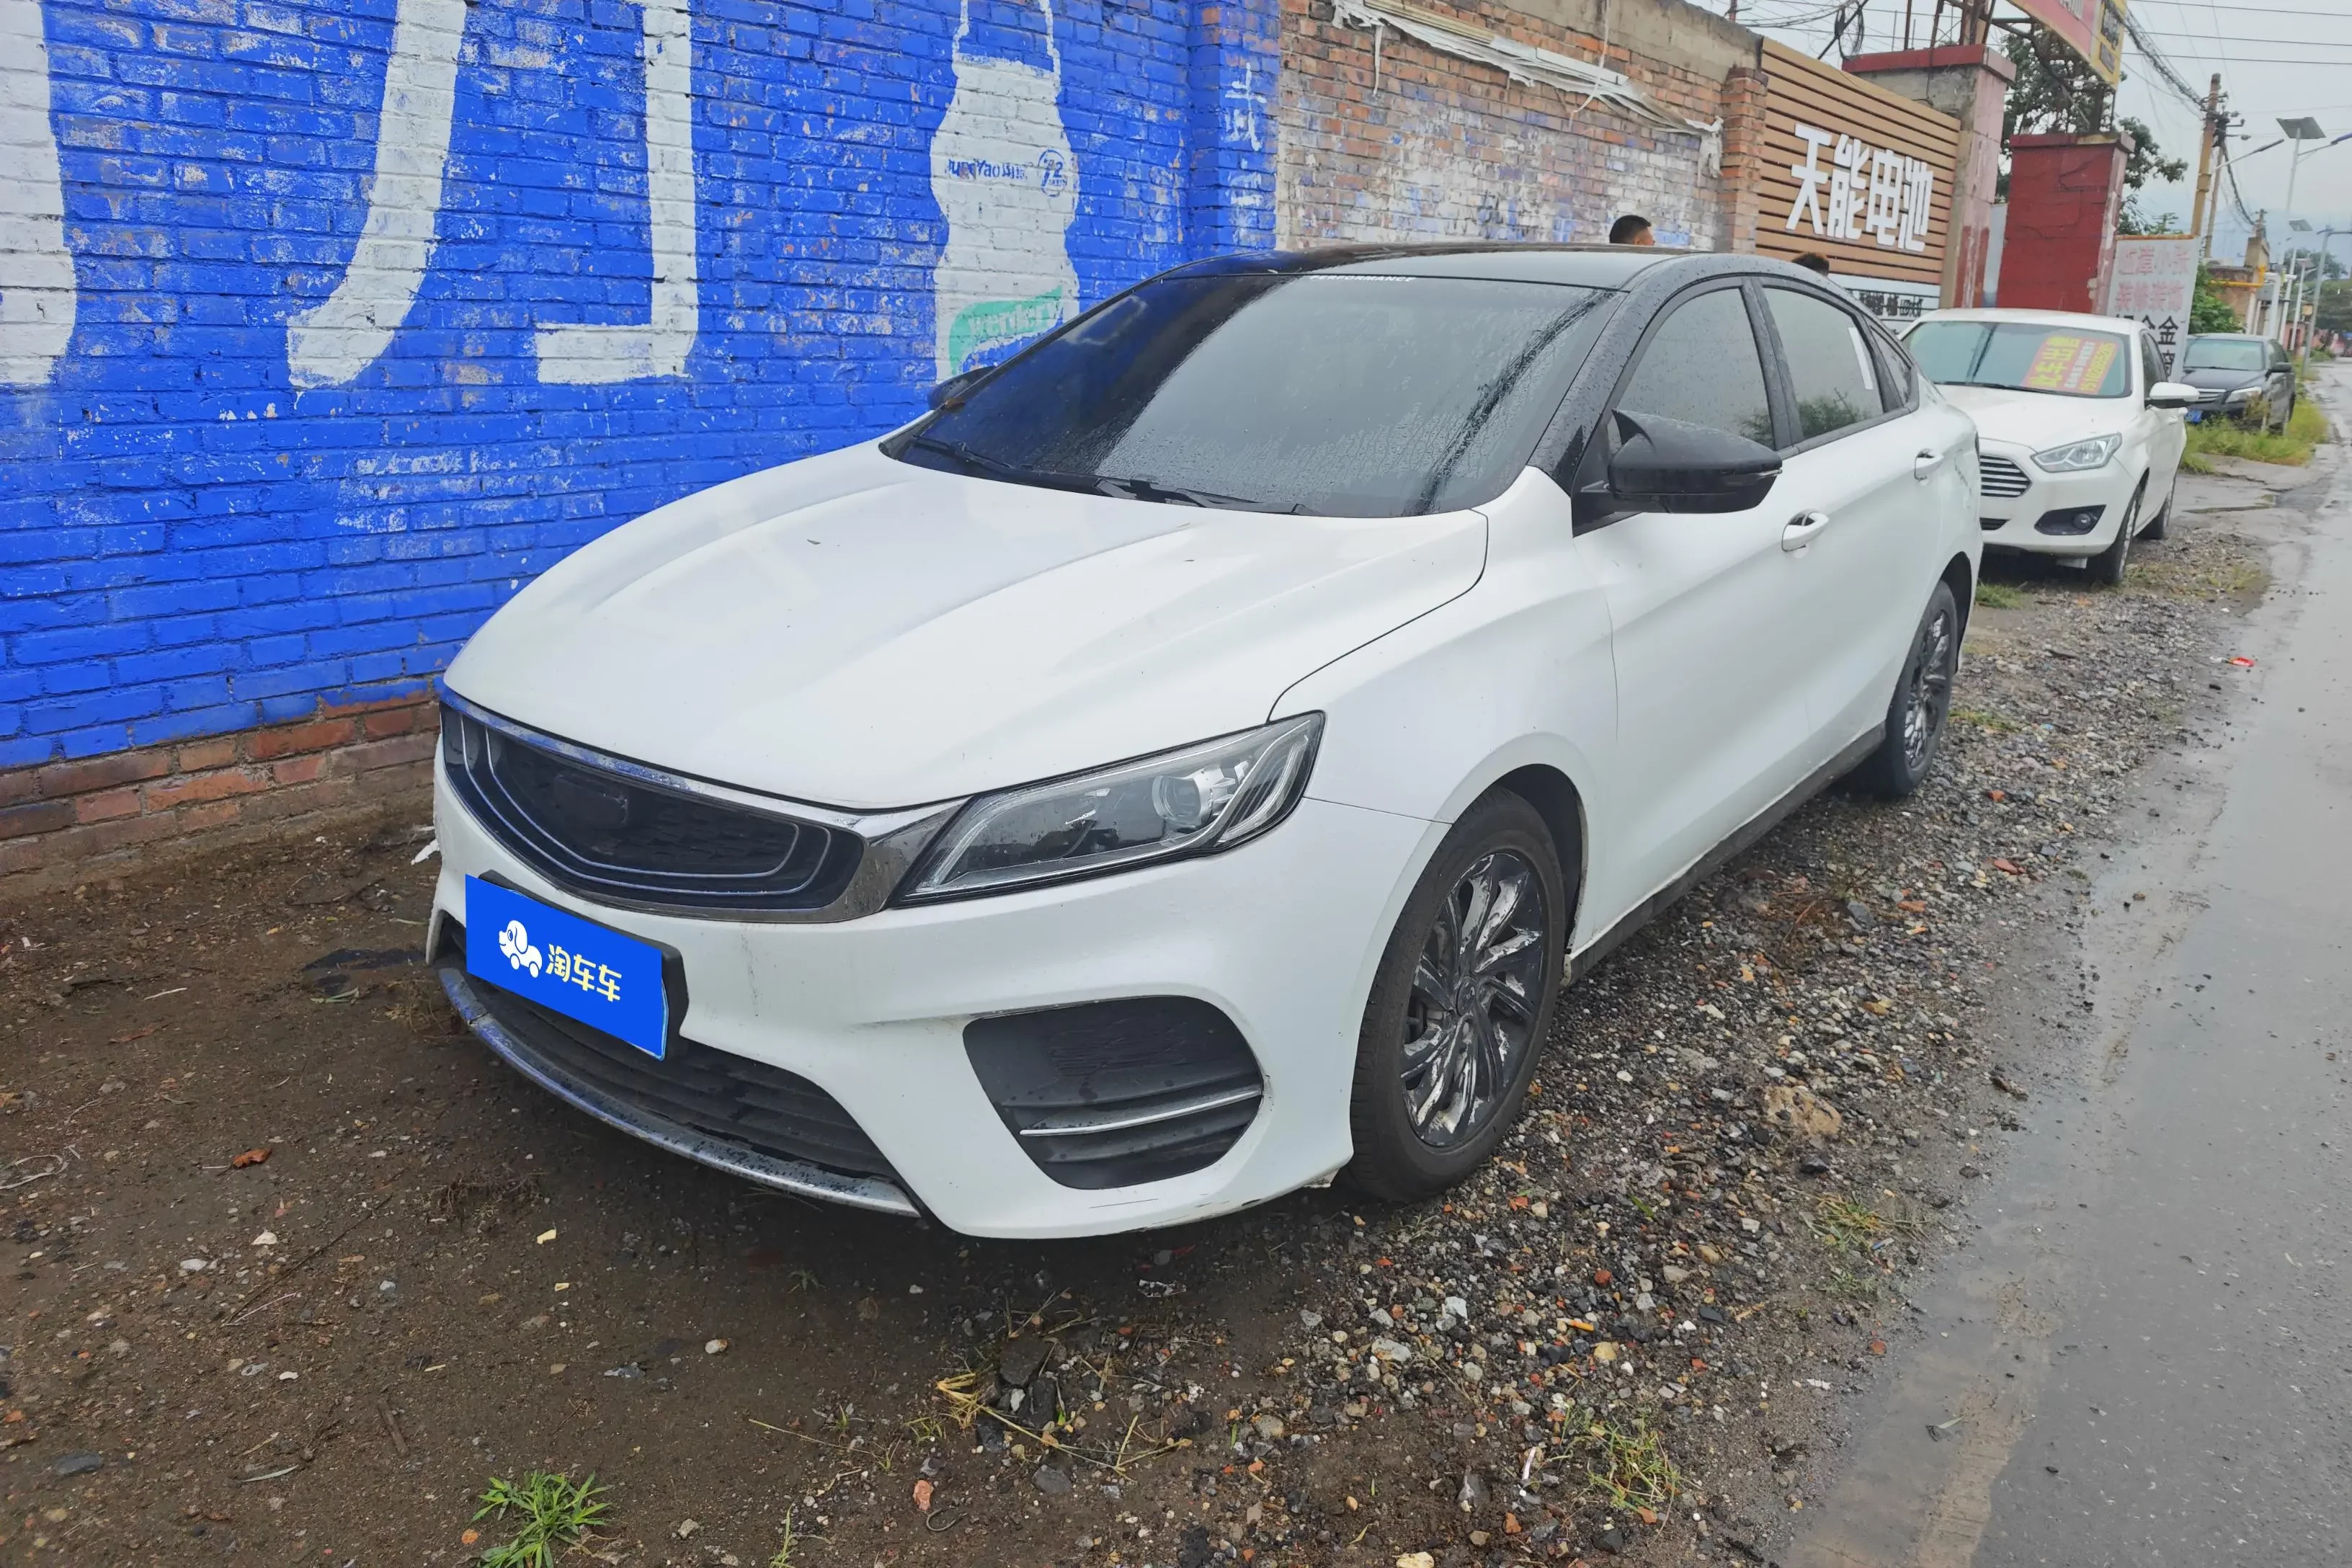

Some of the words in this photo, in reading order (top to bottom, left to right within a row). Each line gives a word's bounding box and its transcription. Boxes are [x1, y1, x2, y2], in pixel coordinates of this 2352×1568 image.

[1785, 123, 1934, 252] 天能电池
[2115, 280, 2185, 313] 装修装饰
[2028, 336, 2082, 388] 此车出售
